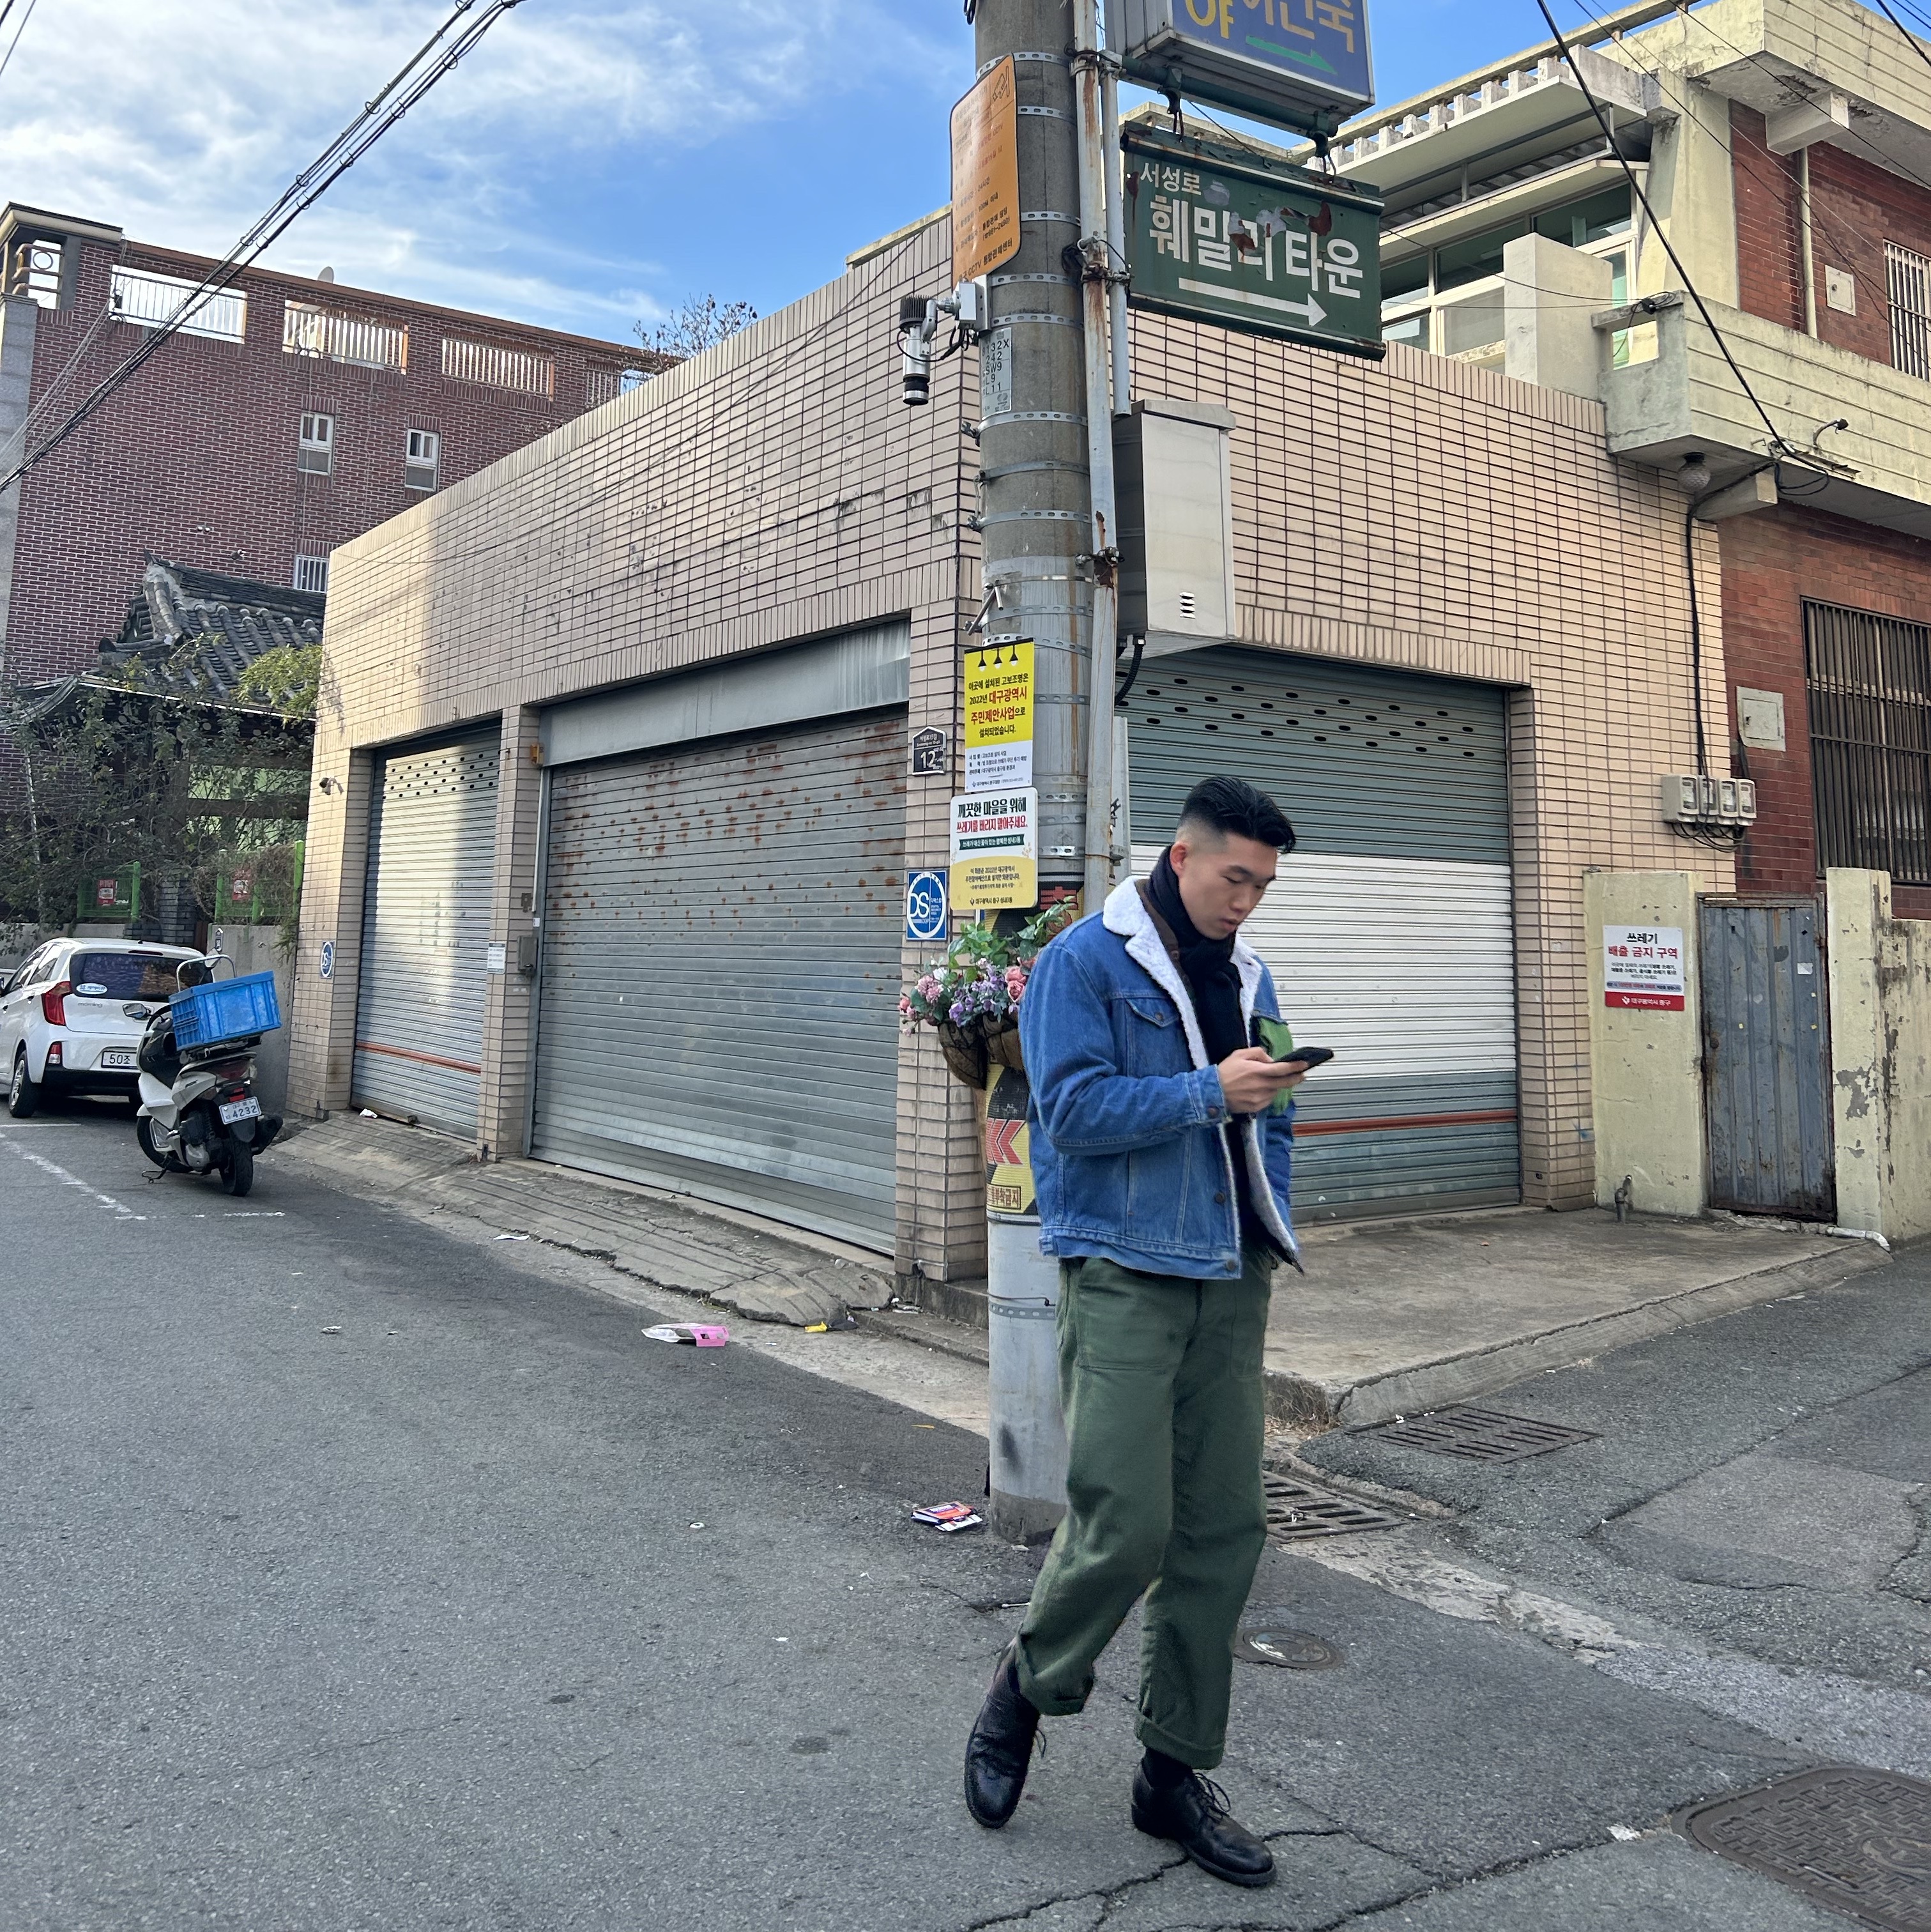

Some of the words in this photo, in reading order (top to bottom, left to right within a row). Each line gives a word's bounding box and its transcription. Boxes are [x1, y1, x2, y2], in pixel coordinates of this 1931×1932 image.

[1140, 162, 1202, 195] 서성로
[968, 259, 982, 276] CCTV
[986, 351, 1002, 365] 242
[968, 680, 983, 691] 이곳에
[985, 677, 1000, 689] 설치된
[1002, 673, 1028, 685] 고보조명은
[970, 694, 988, 705] 2022년
[989, 686, 1027, 704] 대구광역시
[971, 706, 1026, 725] 주민제안사업으로
[979, 724, 1016, 738] 설치되었습니다.
[920, 750, 936, 768] 12
[958, 802, 982, 818] 깨끗한
[984, 799, 1008, 815] 마을을
[1010, 797, 1027, 813] 위해
[956, 820, 979, 834] 쓰레기를
[979, 817, 996, 831] 버리지
[997, 815, 1028, 830] 말아주세요.
[907, 891, 929, 917] DS
[1626, 932, 1658, 944] 쓰레기
[1608, 945, 1628, 957] 배출
[1631, 946, 1653, 958] 금지
[1657, 947, 1678, 960] 구역
[109, 1054, 130, 1064] 50조
[233, 1105, 257, 1118] 4232
